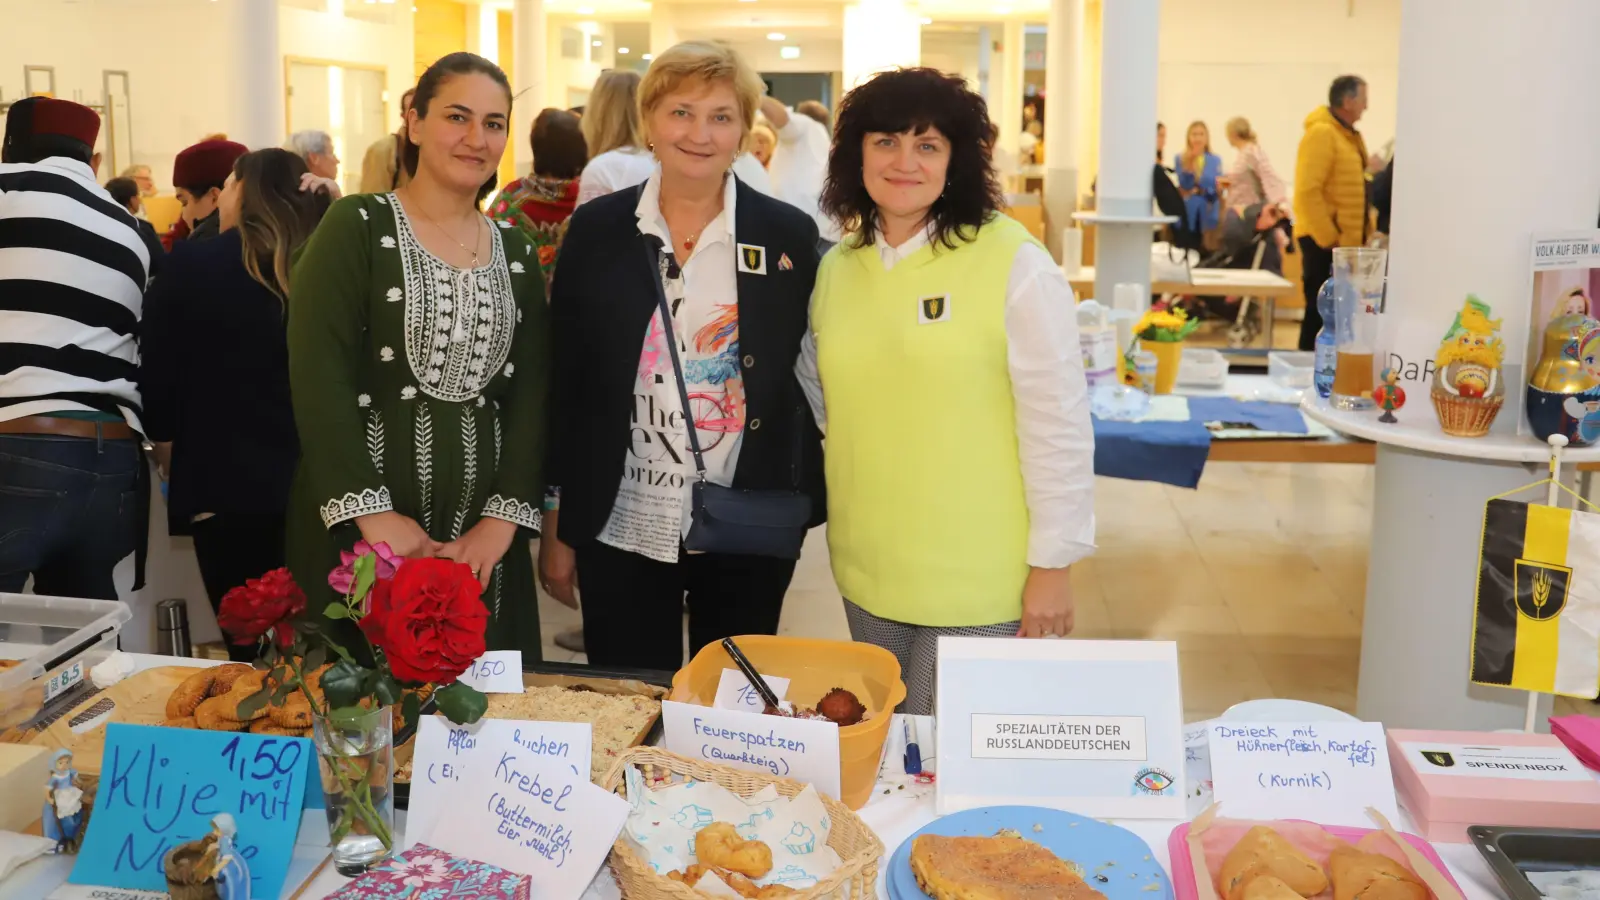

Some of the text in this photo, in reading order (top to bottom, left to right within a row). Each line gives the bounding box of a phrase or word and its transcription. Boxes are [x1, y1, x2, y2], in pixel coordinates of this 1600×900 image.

[1535, 244, 1554, 257] VOLK
[1556, 243, 1571, 256] AUF
[1572, 243, 1589, 255] DEM
[470, 660, 506, 680] 1,50
[693, 717, 806, 754] Feuerspatzen
[995, 722, 1121, 736] SPEZIALITÄTEN DER
[1214, 725, 1319, 739] Dreieck mit
[986, 737, 1131, 751] RUSSLANDDEUTSCHEN
[221, 735, 302, 781] 1,50
[1465, 761, 1569, 772] SPENDENBOX
[104, 743, 294, 834] Klije mit
[494, 751, 573, 812] Krebel
